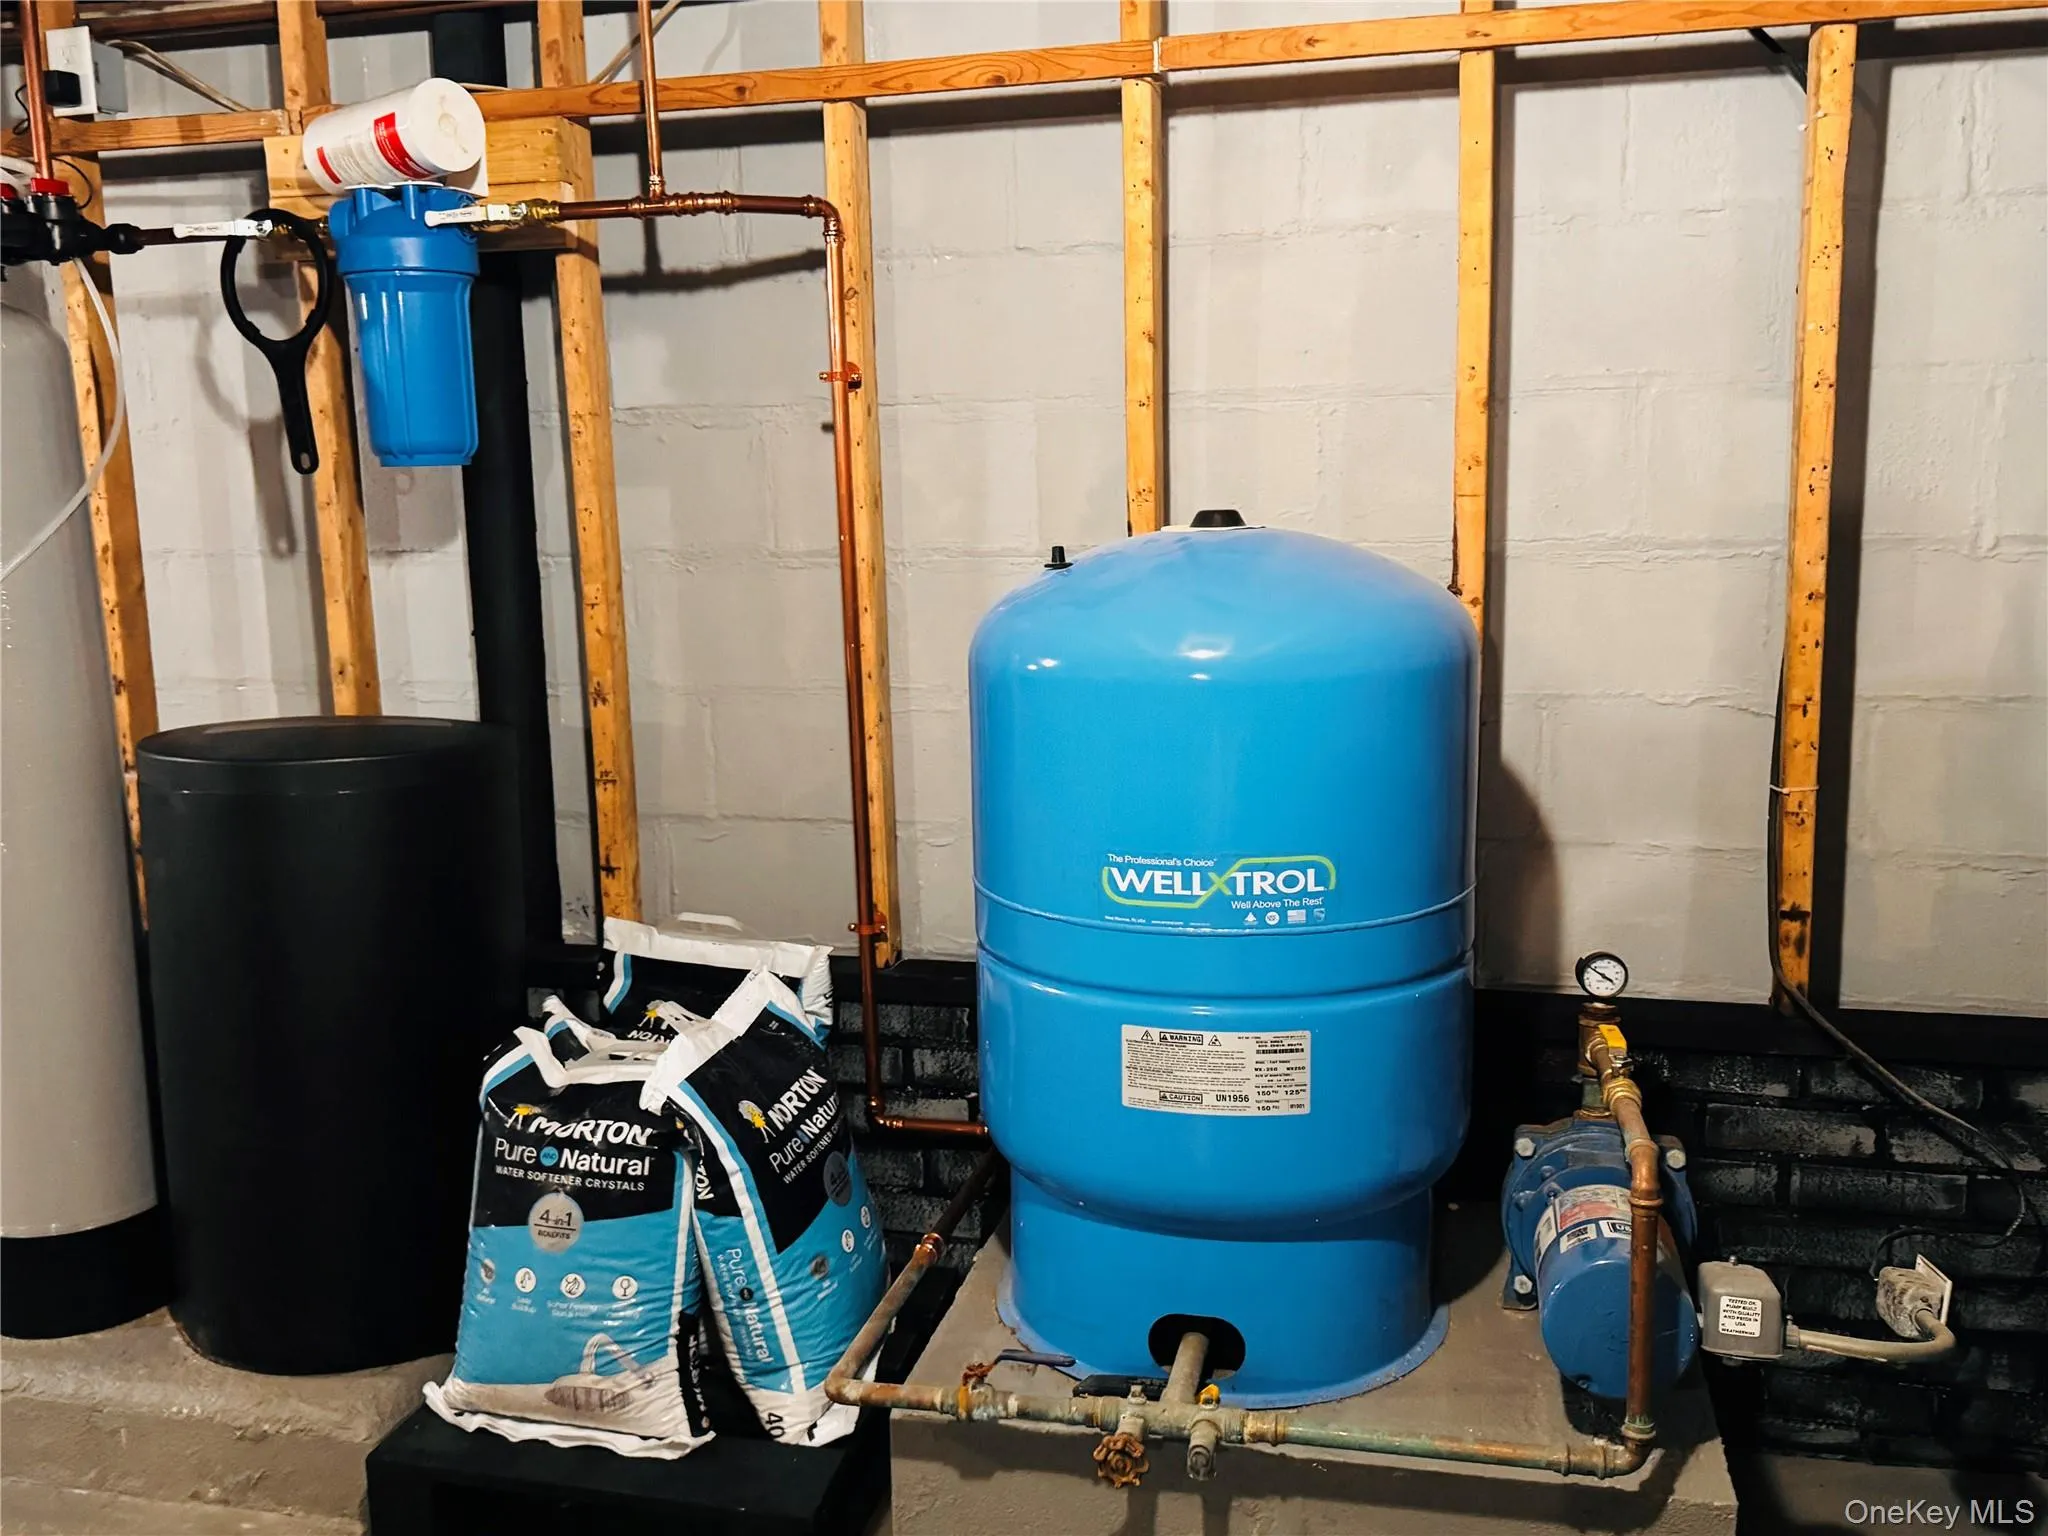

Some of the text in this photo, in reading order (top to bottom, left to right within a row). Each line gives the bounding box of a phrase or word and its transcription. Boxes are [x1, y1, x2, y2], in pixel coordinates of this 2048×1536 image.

[1107, 853, 1215, 867] The Professional's Choice
[1231, 897, 1323, 909] Well Above The Rest
[1169, 1034, 1202, 1043] WARNING
[767, 1067, 828, 1131] MORTON
[1169, 1093, 1201, 1102] CAUTION
[1215, 1094, 1250, 1103] UN1956
[528, 1116, 653, 1146] MORTON
[769, 1137, 805, 1174] Pure
[800, 1092, 839, 1140] Natur
[494, 1137, 538, 1165] Pure
[559, 1148, 650, 1177] Natural
[495, 1165, 645, 1191] WATER SOFTENER CRYSTALS
[783, 1161, 808, 1184] WATER
[727, 1248, 748, 1287] Pure
[765, 1411, 787, 1440] 40
